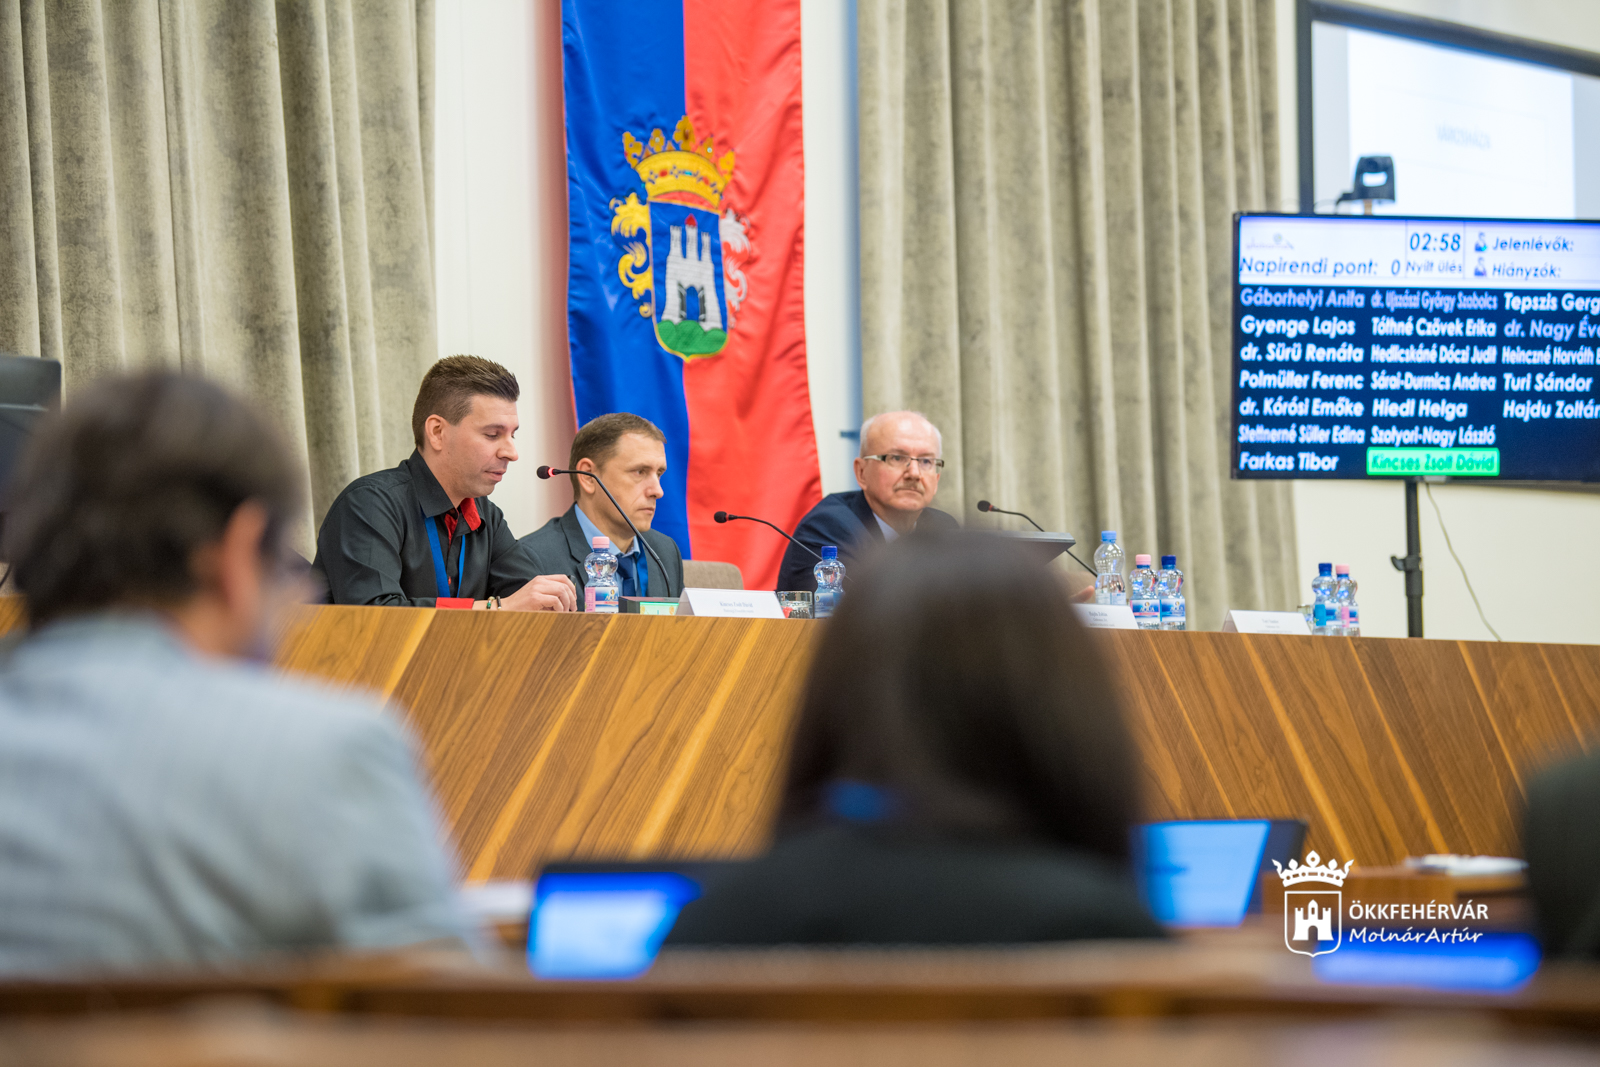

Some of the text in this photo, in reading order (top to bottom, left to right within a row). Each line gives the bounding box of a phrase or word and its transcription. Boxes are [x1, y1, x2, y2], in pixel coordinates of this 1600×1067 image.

[1410, 232, 1461, 252] 02:58
[1492, 235, 1574, 252] Jelenlévők:
[1240, 257, 1400, 277] Napirendi pont: 0
[1492, 262, 1562, 280] Hiányzók:
[1240, 286, 1366, 311] Gáborhelyi Anita
[1456, 291, 1498, 310] Szabolcs
[1504, 292, 1558, 314] Tepszis
[1240, 315, 1356, 339] Gyenge Lajos
[1371, 315, 1414, 336] Tóthné
[1465, 318, 1498, 338] Erika
[1504, 318, 1526, 338] dr.
[1529, 319, 1575, 342] Nagy
[1240, 342, 1263, 362] dr.
[1305, 342, 1364, 362] Renáta
[1471, 344, 1498, 364] Judit
[1502, 344, 1552, 365] Heinczné
[1552, 344, 1594, 365] Horváth
[1311, 370, 1364, 390] Ferenc
[1452, 371, 1497, 391] Andrea
[1503, 371, 1593, 392] Turi Sándor
[1239, 396, 1260, 416] dr.
[1311, 396, 1364, 416] Emőke
[1372, 398, 1468, 422] Hiedl Helga
[1502, 399, 1552, 422] Hajdu
[1332, 424, 1366, 444] Edina
[1458, 424, 1496, 445] László
[1239, 451, 1340, 471] Farkas Tibor
[1372, 452, 1494, 471] Kincses Zsolt Dávid
